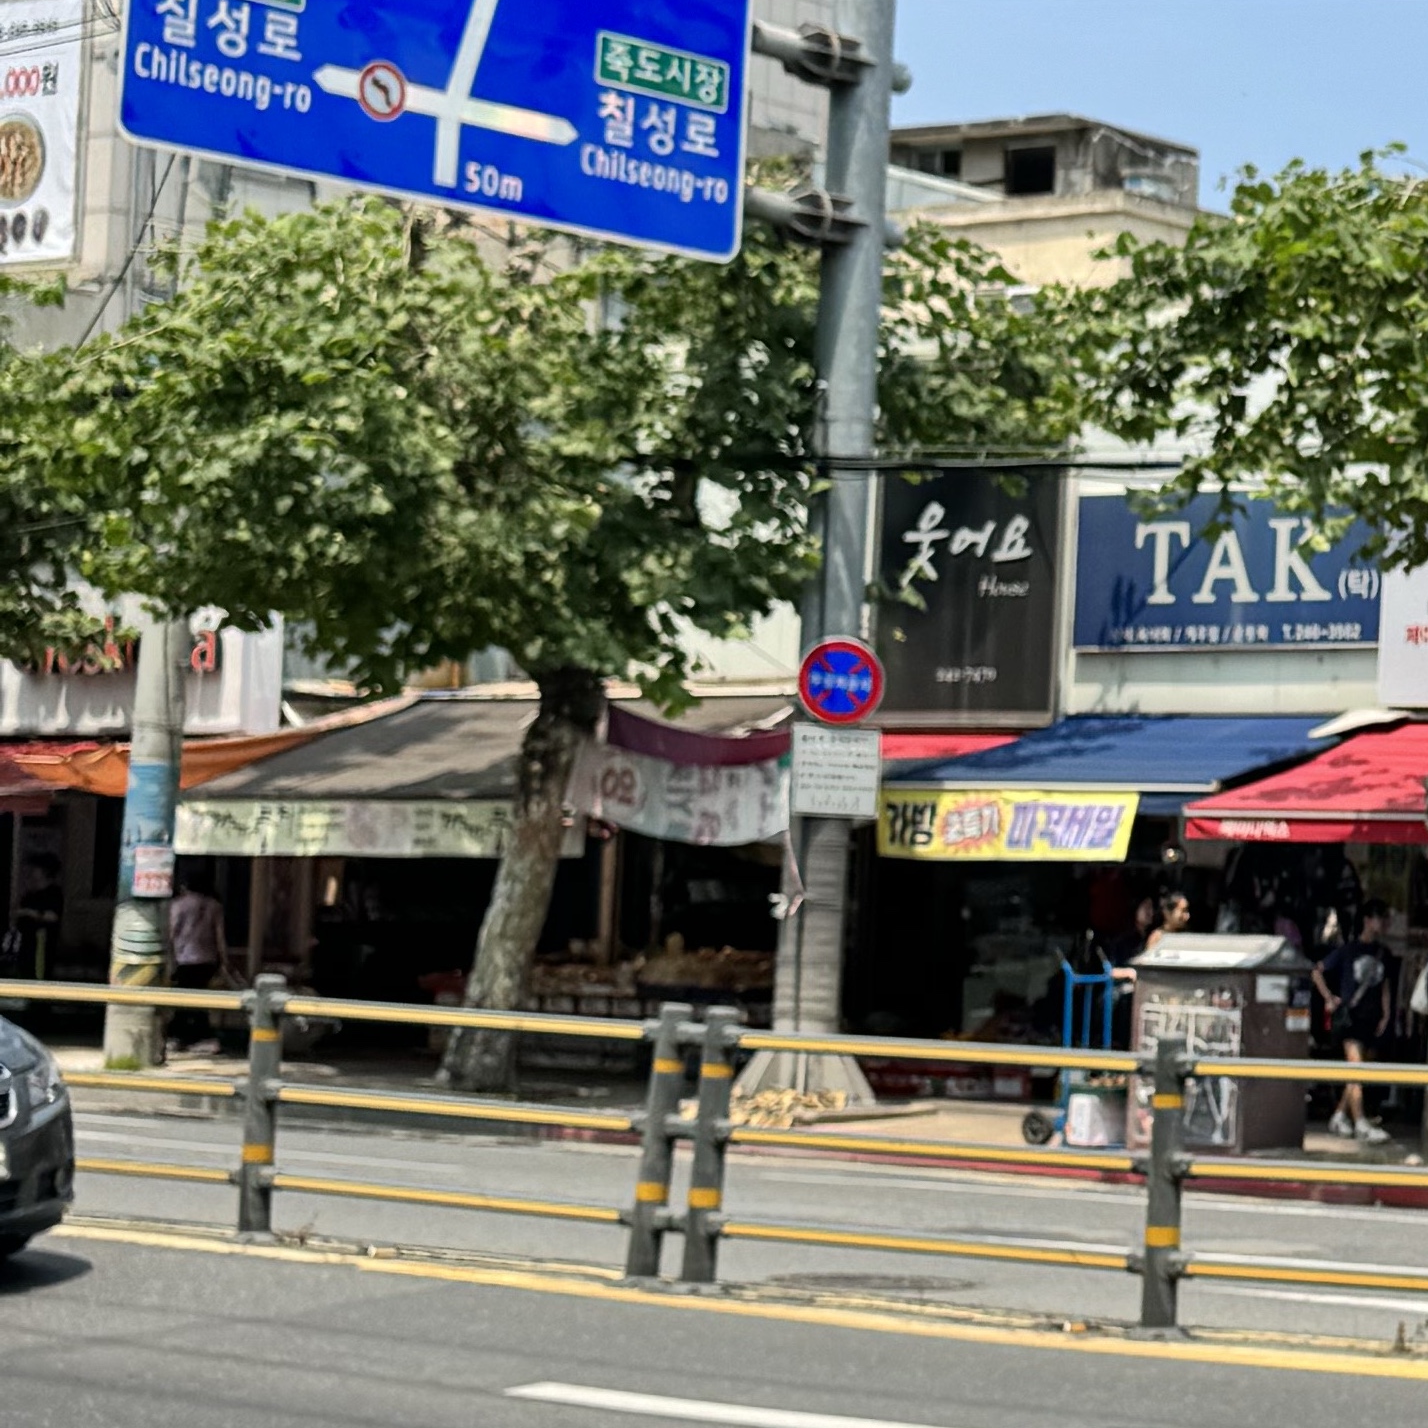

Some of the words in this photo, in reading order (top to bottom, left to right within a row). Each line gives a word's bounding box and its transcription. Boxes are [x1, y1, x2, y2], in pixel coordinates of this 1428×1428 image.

[134, 42, 312, 114] Chilseong-ro
[604, 41, 723, 104] 죽도시장
[598, 90, 720, 158] 칠성로
[464, 160, 523, 203] 50m
[580, 142, 729, 205] Chilseong-ro
[1134, 517, 1333, 604] TAK
